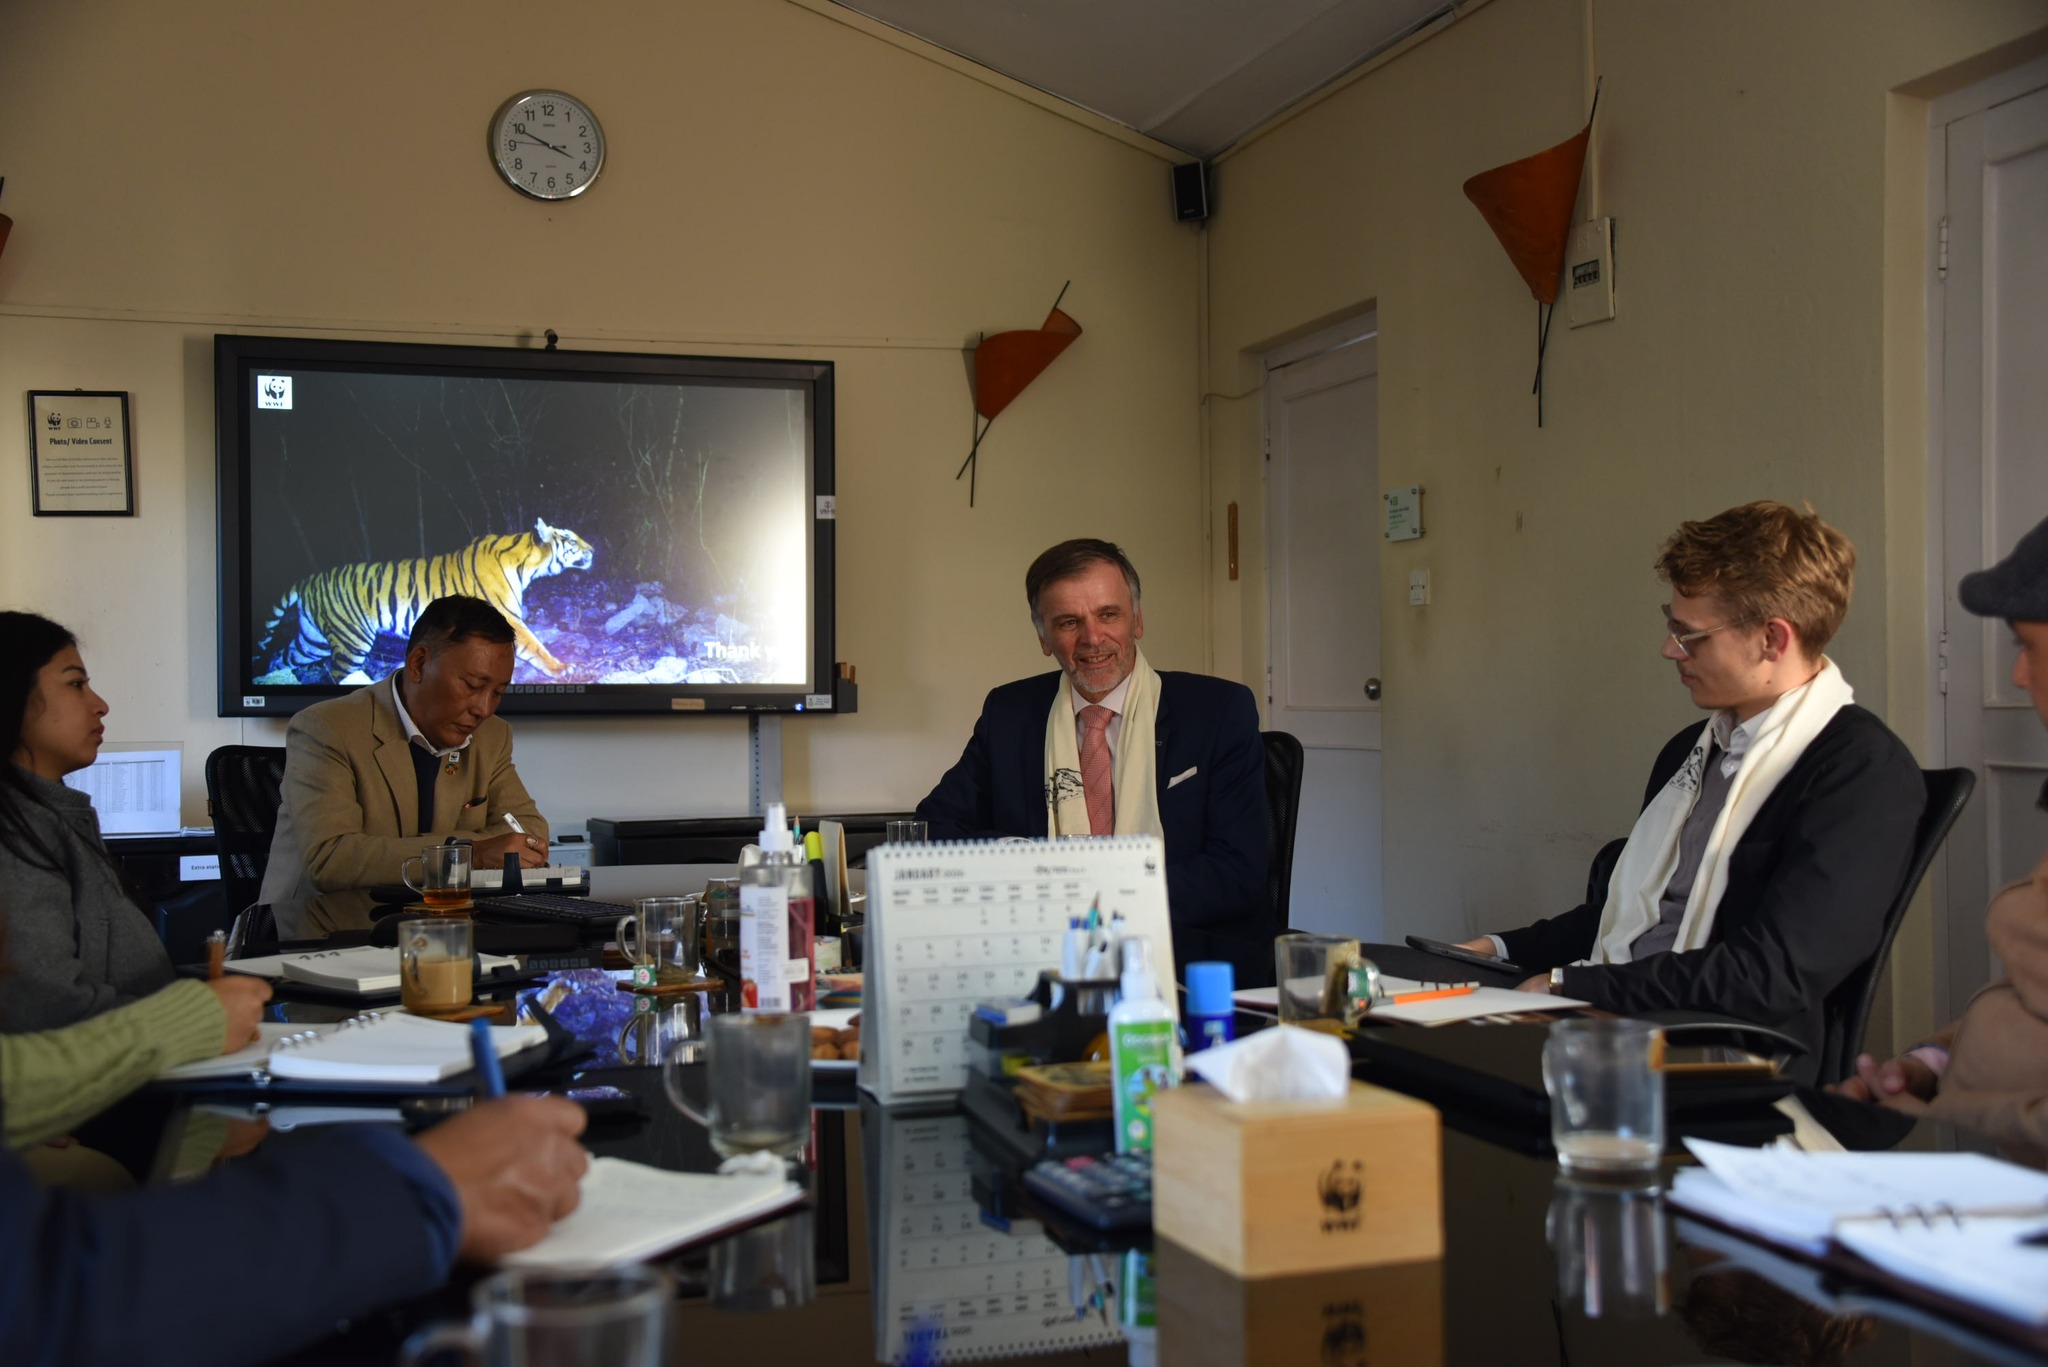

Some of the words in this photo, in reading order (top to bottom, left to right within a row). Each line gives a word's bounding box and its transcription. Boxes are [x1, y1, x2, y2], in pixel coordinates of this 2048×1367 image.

[524, 110, 535, 121] 11
[541, 104, 555, 116] 12
[565, 111, 570, 122] 1
[512, 123, 525, 134] 10
[579, 126, 587, 137] 2
[508, 140, 516, 151] 9
[583, 142, 591, 154] 3
[514, 158, 522, 170] 8
[579, 161, 587, 171] 4
[530, 172, 537, 184] 7
[547, 177, 556, 188] 6
[566, 173, 573, 184] 5
[49, 438, 70, 446] Photo/
[71, 437, 88, 445] Video
[89, 437, 112, 445] Consent
[704, 641, 760, 659] Thank
